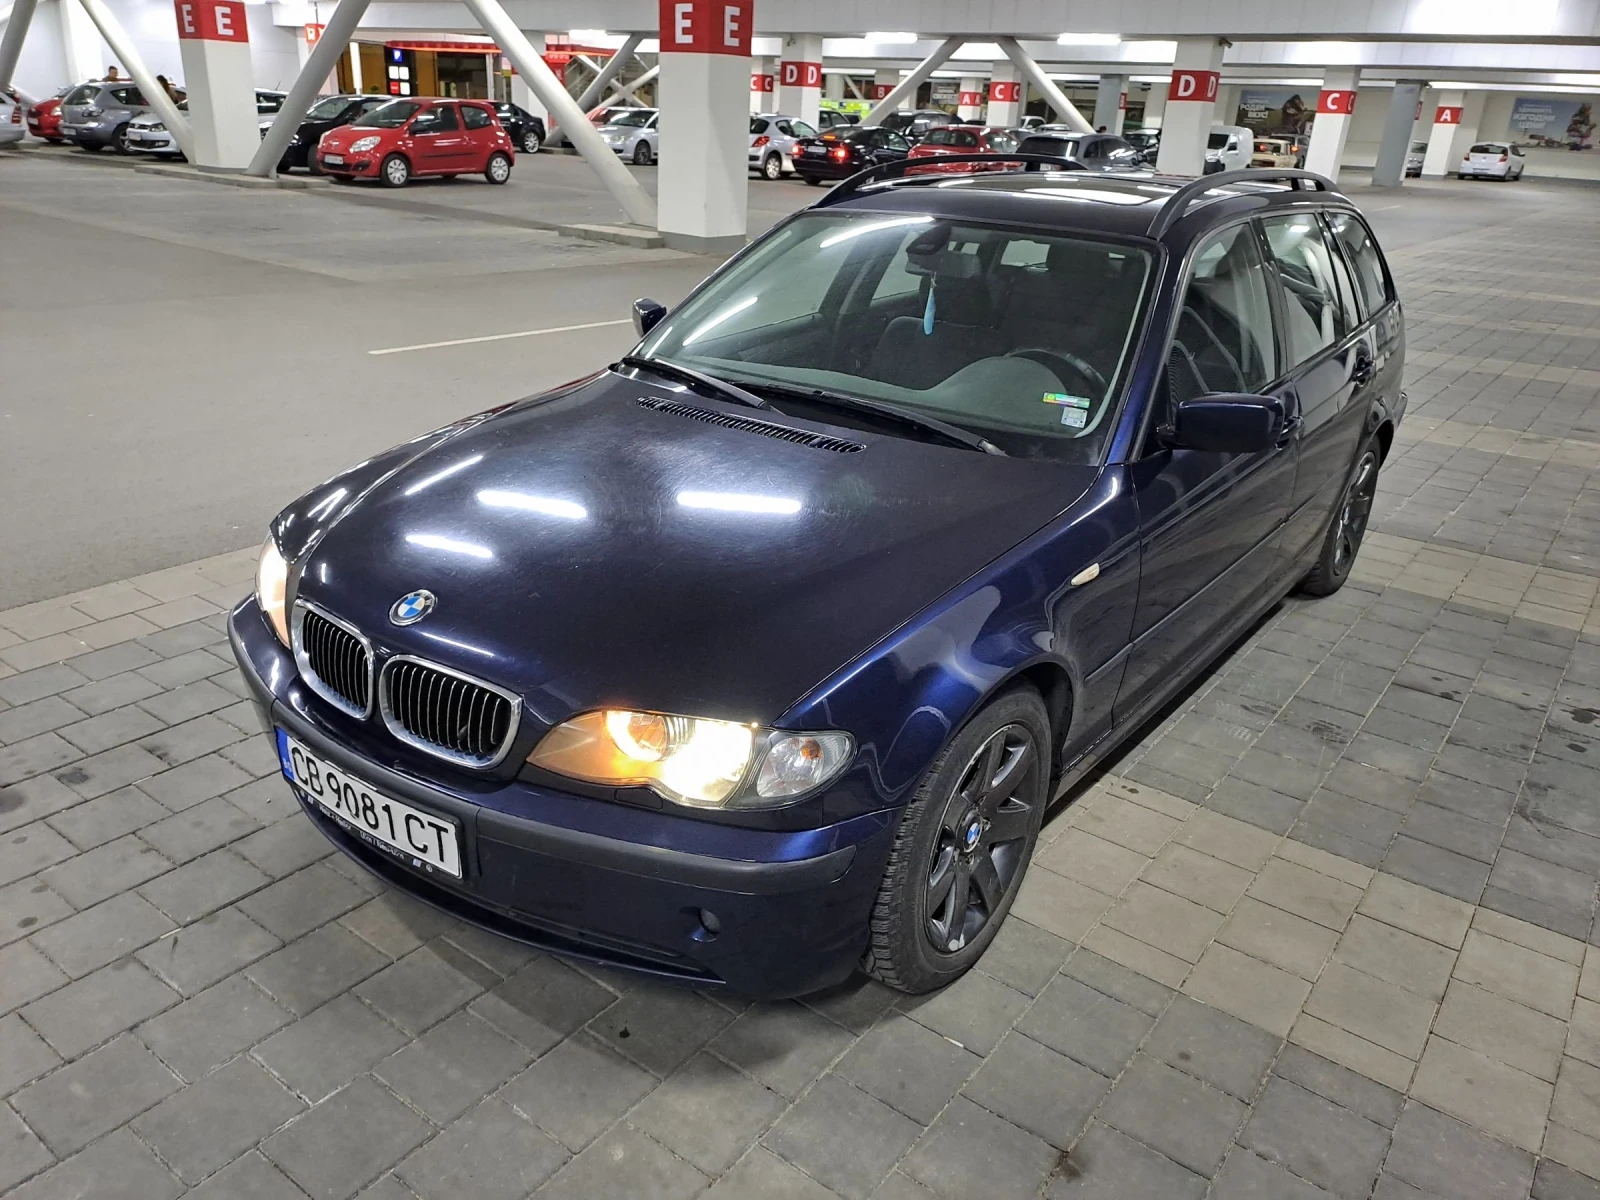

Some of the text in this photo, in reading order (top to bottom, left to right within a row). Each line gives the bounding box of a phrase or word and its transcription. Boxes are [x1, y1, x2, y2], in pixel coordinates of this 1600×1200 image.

[181, 4, 195, 33] E
[214, 6, 234, 36] E
[675, 3, 693, 44] E
[724, 5, 740, 47] E
[750, 76, 758, 90] C
[785, 64, 798, 83] D
[807, 65, 818, 84] D
[764, 77, 772, 90] C
[877, 86, 885, 98] B
[994, 84, 1004, 99] C
[1177, 74, 1196, 97] D
[1206, 75, 1216, 98] D
[962, 93, 971, 104] A
[1326, 92, 1340, 110] C
[1439, 109, 1452, 122] A
[291, 747, 324, 796] CB
[326, 772, 396, 841] 9081
[404, 813, 449, 862] CT
